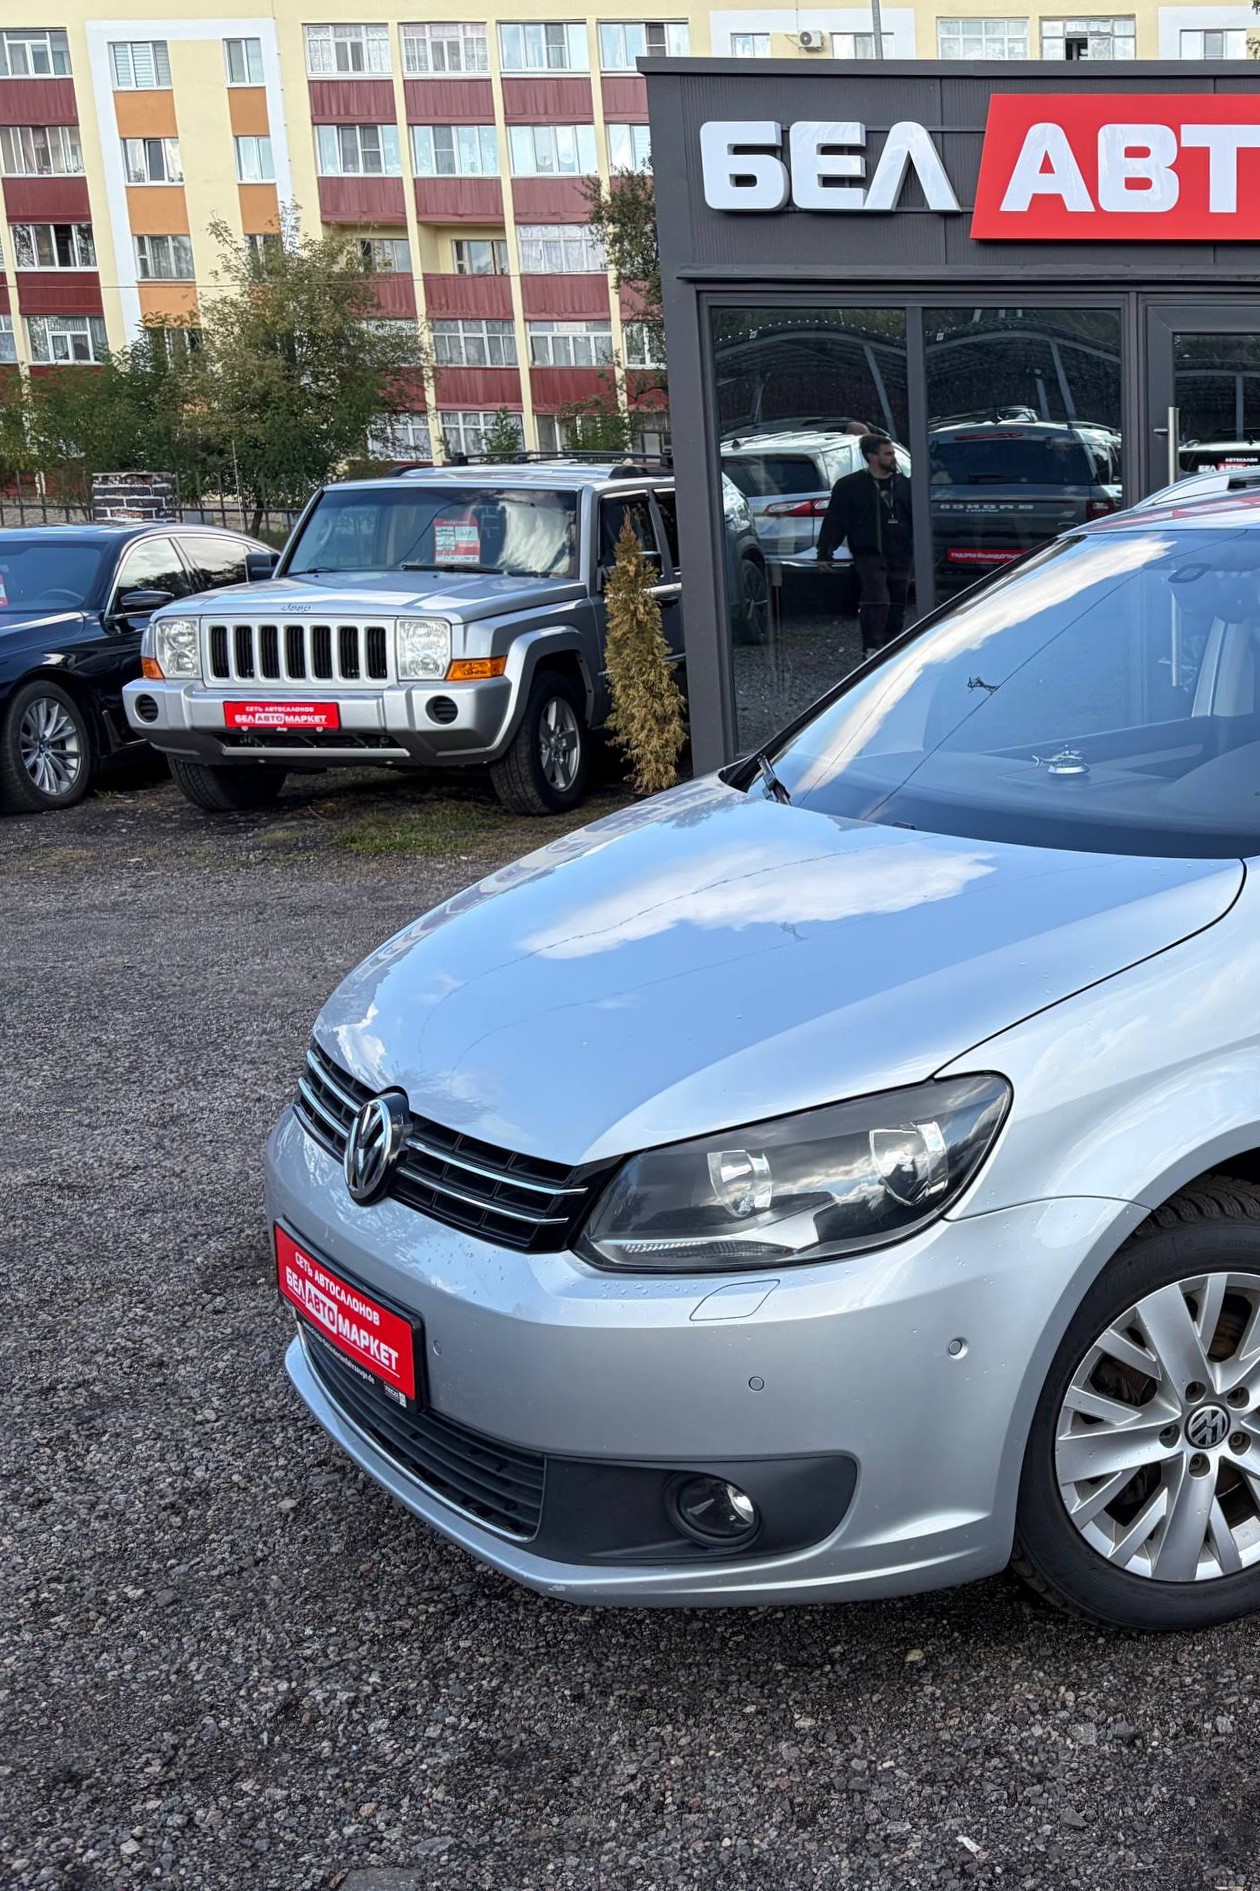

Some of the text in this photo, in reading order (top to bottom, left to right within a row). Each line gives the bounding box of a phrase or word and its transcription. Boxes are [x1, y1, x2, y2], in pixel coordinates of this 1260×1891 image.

[700, 120, 961, 212] БЕЛ
[235, 714, 327, 723] БЕЛ АВТО МАРКЕТ
[286, 1266, 306, 1301] БЕЛ
[306, 1283, 337, 1332] АВТО
[338, 1314, 399, 1371] МАРКЕТ
[295, 1251, 380, 1327] СЕТЬ АВТОСАЛОНОВ
